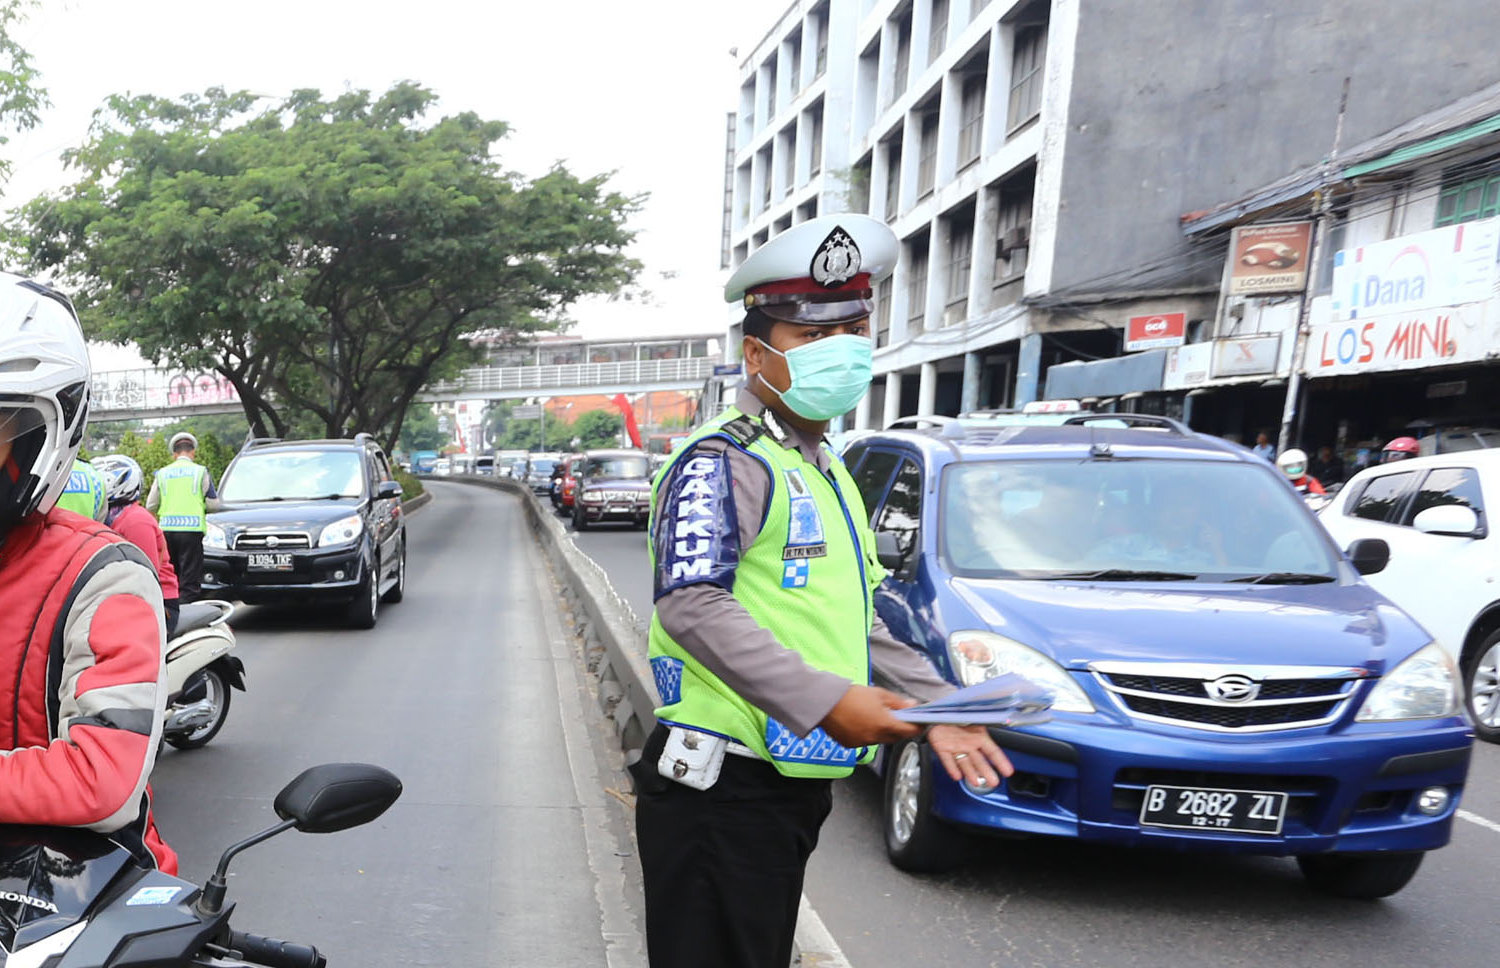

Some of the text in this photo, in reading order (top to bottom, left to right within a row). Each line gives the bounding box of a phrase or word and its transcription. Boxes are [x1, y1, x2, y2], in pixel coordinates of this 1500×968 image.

[1364, 275, 1425, 307] Dana
[1320, 315, 1453, 367] LOS MINI
[672, 457, 716, 580] GAKKUM
[248, 554, 255, 565] B
[255, 554, 274, 565] 1094
[1148, 788, 1279, 820] B 2682 ZL
